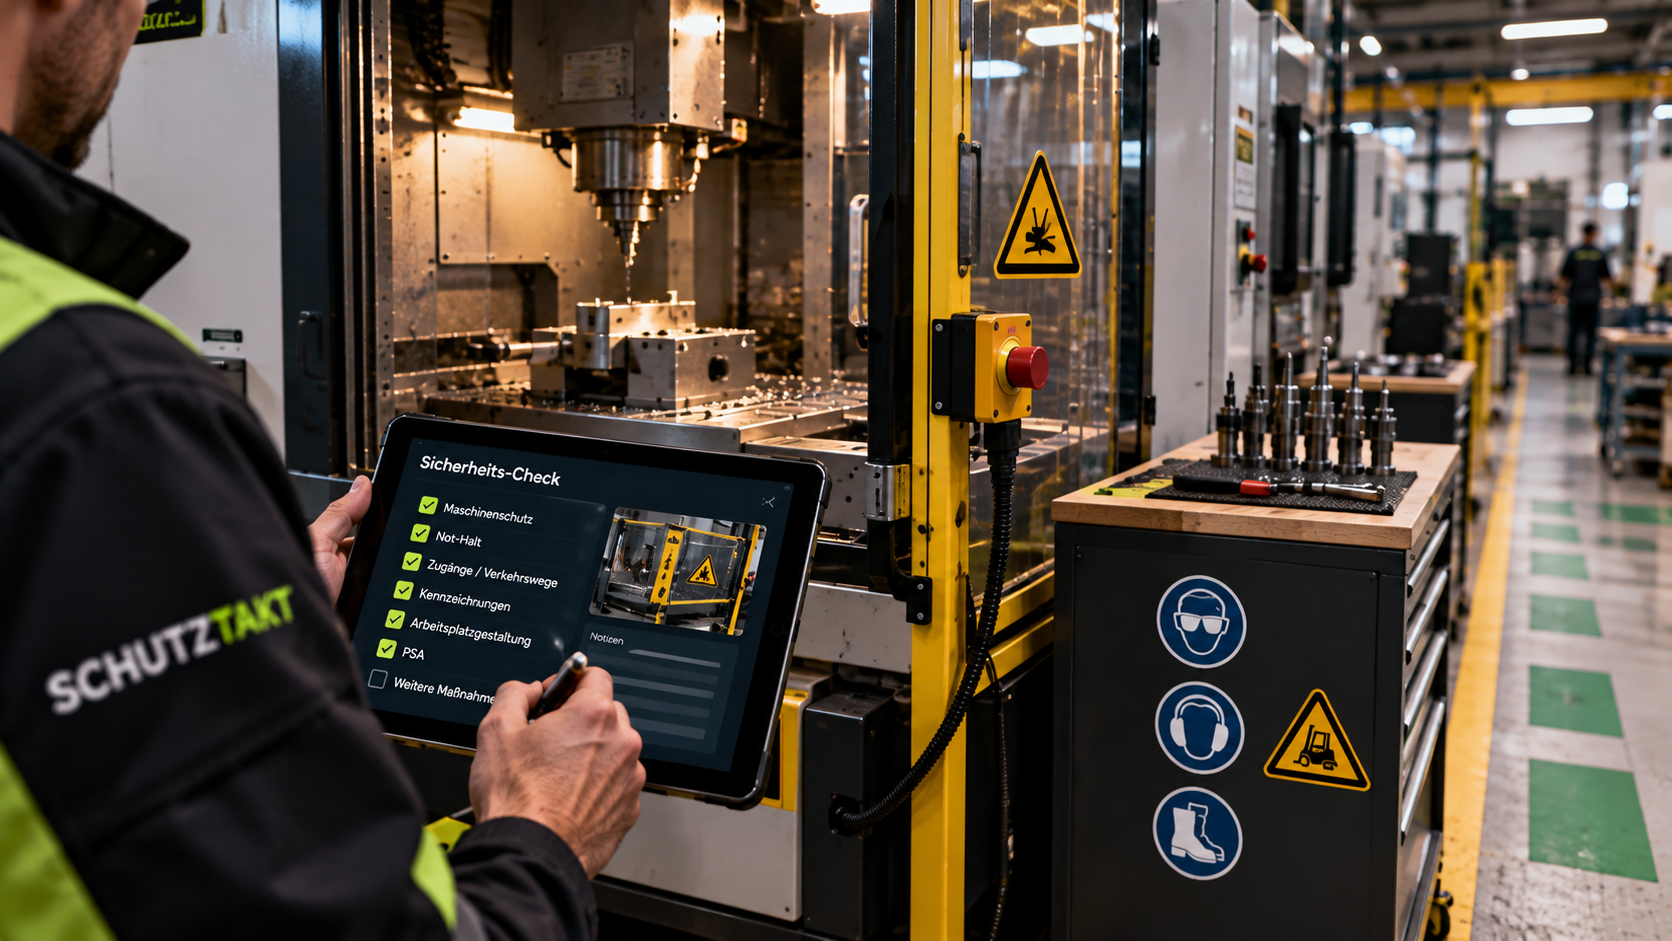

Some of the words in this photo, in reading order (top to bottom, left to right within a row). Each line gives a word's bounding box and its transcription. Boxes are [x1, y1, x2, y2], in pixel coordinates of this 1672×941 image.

[420, 455, 561, 486] Sicherheits-Check
[444, 502, 533, 525] Maschinenschutz
[436, 530, 482, 548] Not-Halt
[484, 567, 558, 589] Verkehrswege
[410, 617, 532, 648] Arbeitsplatzgestaltung
[46, 584, 293, 714] SCHUTZTAKT
[402, 646, 425, 661] PSA
[394, 676, 435, 694] Weitere
